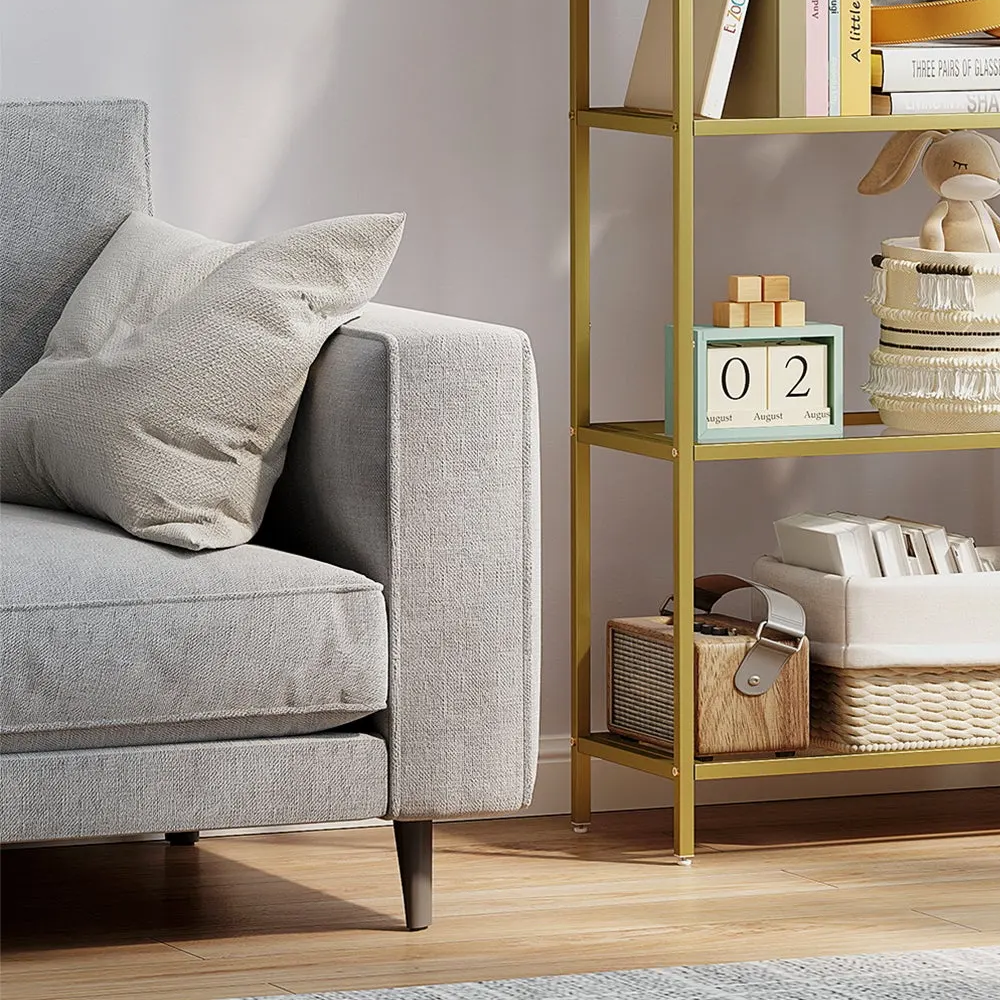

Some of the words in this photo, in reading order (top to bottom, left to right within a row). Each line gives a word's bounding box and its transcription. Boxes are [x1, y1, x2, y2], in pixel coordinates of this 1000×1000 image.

[849, 0, 861, 41] little
[851, 48, 861, 62] A
[912, 60, 935, 78] THREE
[938, 59, 960, 77] PAIRS
[962, 59, 972, 77] OF
[753, 412, 783, 422] August
